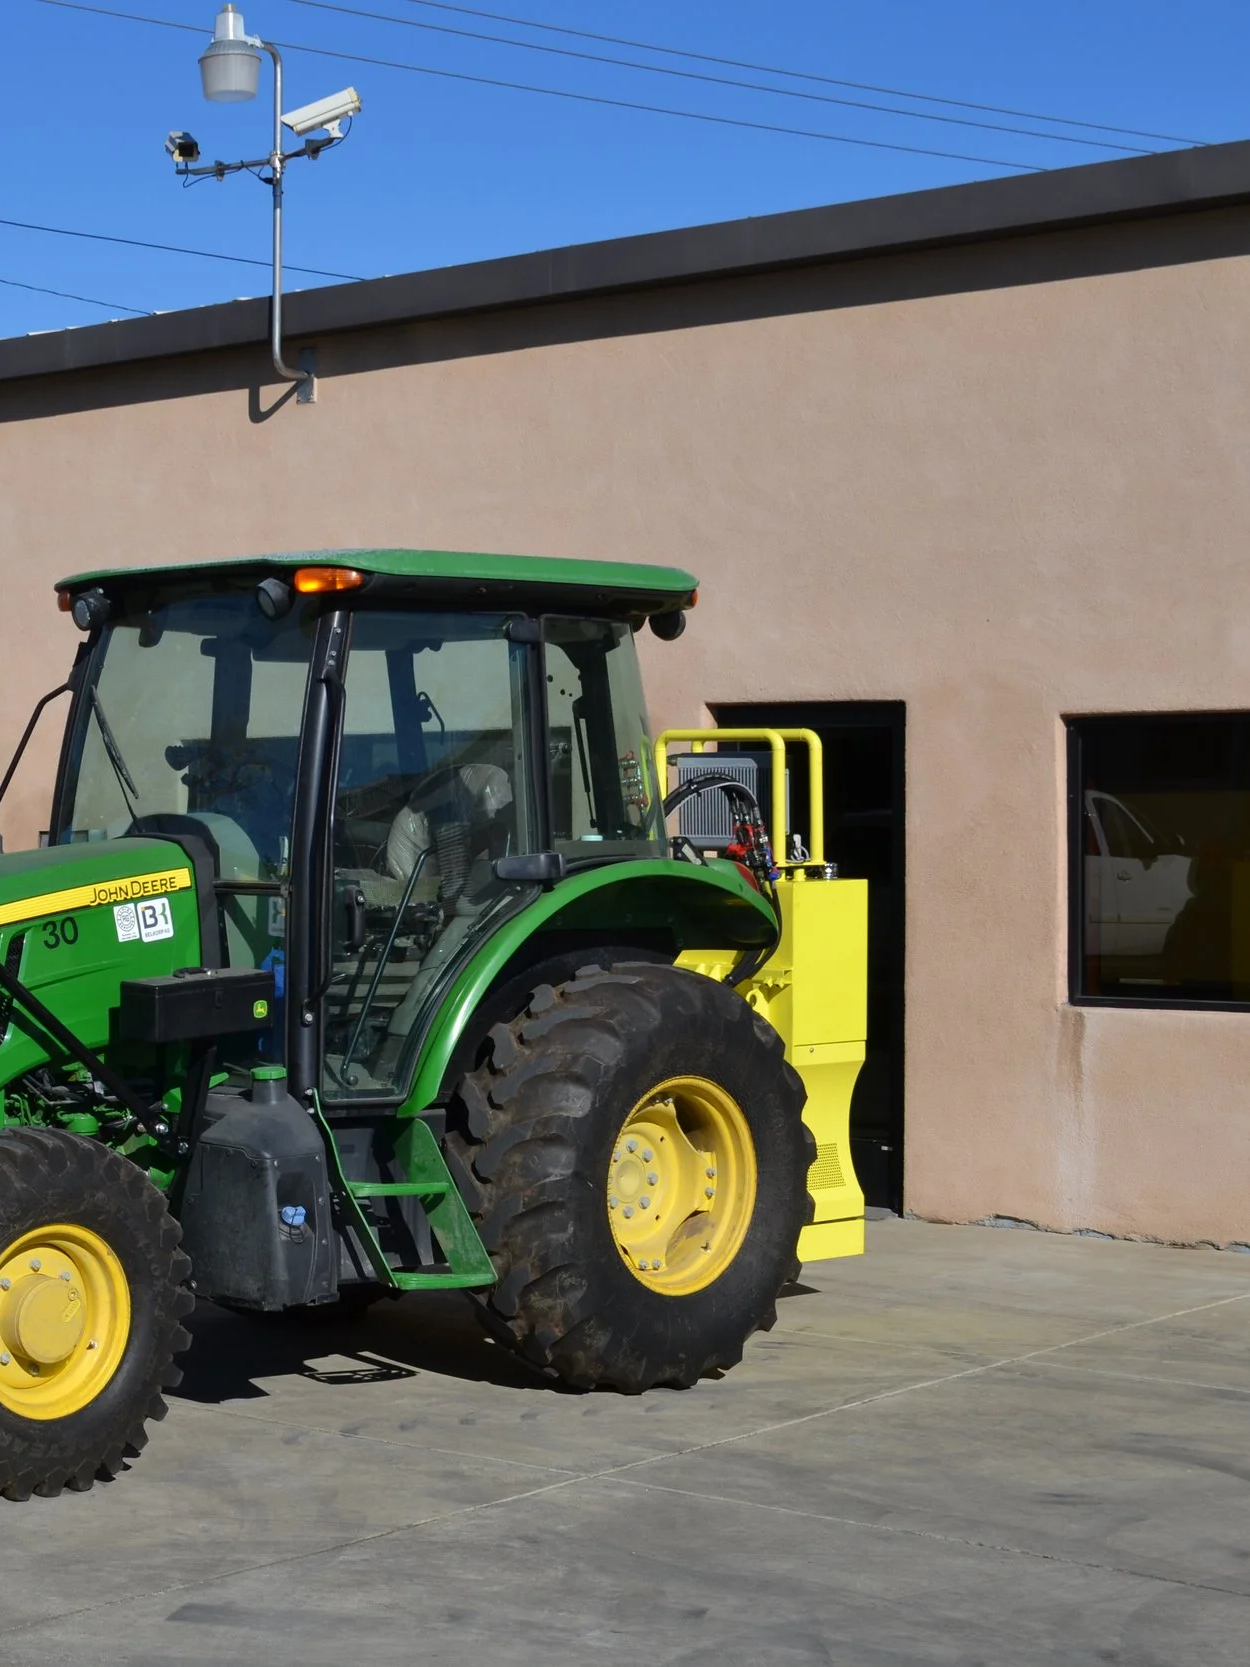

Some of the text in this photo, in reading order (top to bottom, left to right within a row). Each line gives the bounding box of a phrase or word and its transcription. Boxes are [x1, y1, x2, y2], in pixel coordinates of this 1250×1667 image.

[90, 877, 177, 904] JOHN DEERE
[42, 916, 79, 949] 30
